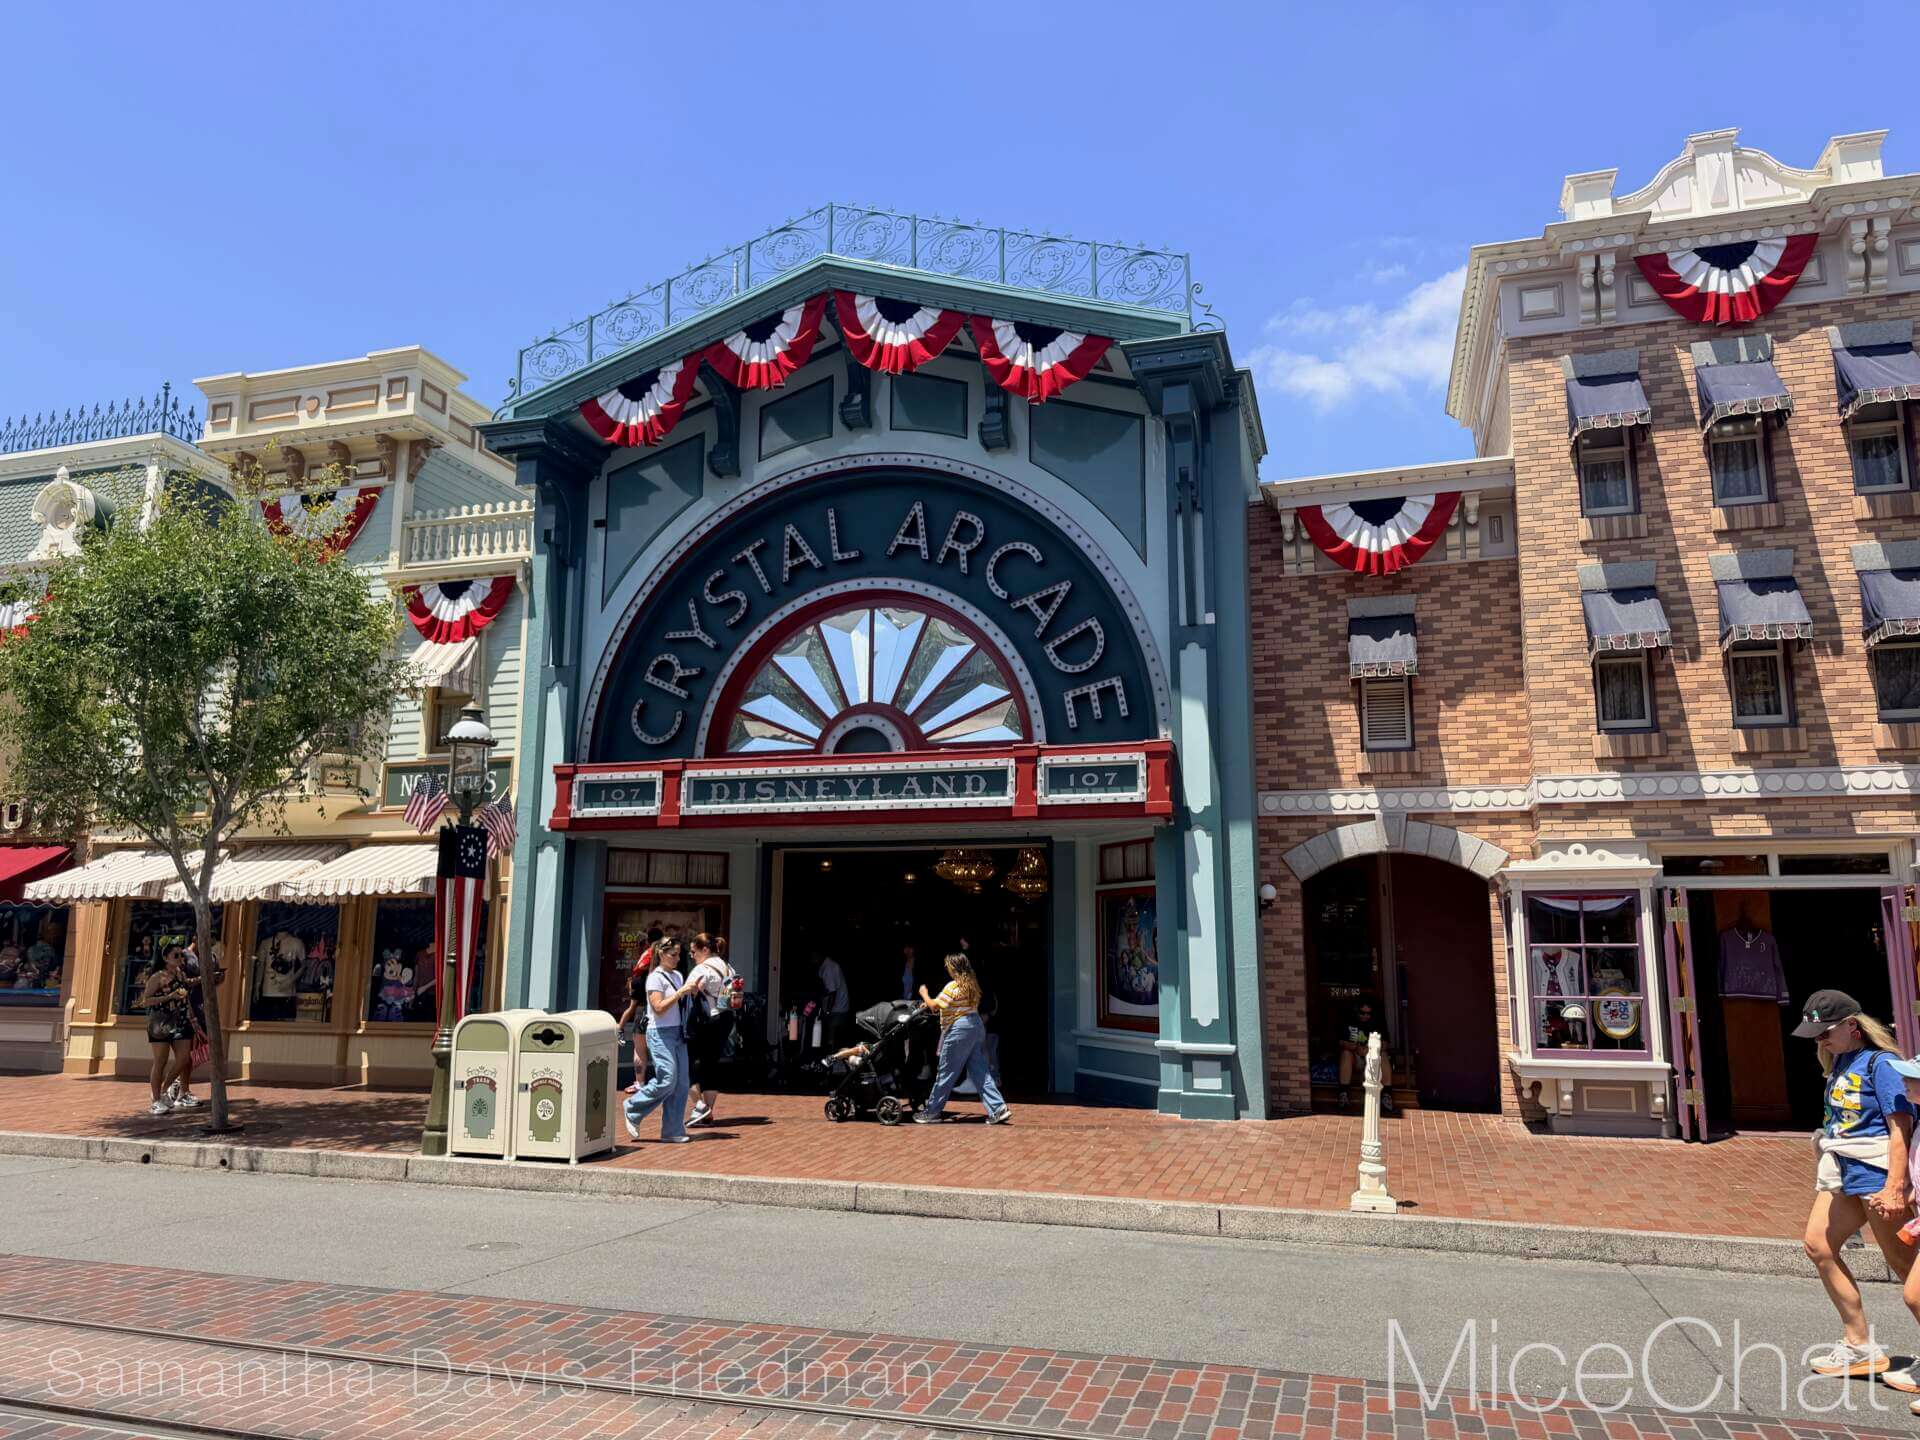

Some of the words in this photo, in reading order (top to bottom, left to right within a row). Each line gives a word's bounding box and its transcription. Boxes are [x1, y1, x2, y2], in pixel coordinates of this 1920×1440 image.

[631, 507, 862, 745] CRYSTAL
[886, 500, 1130, 729] ARCADE
[709, 774, 988, 801] DISNEYLAND
[1069, 772, 1118, 787] 107
[600, 788, 640, 802] 107
